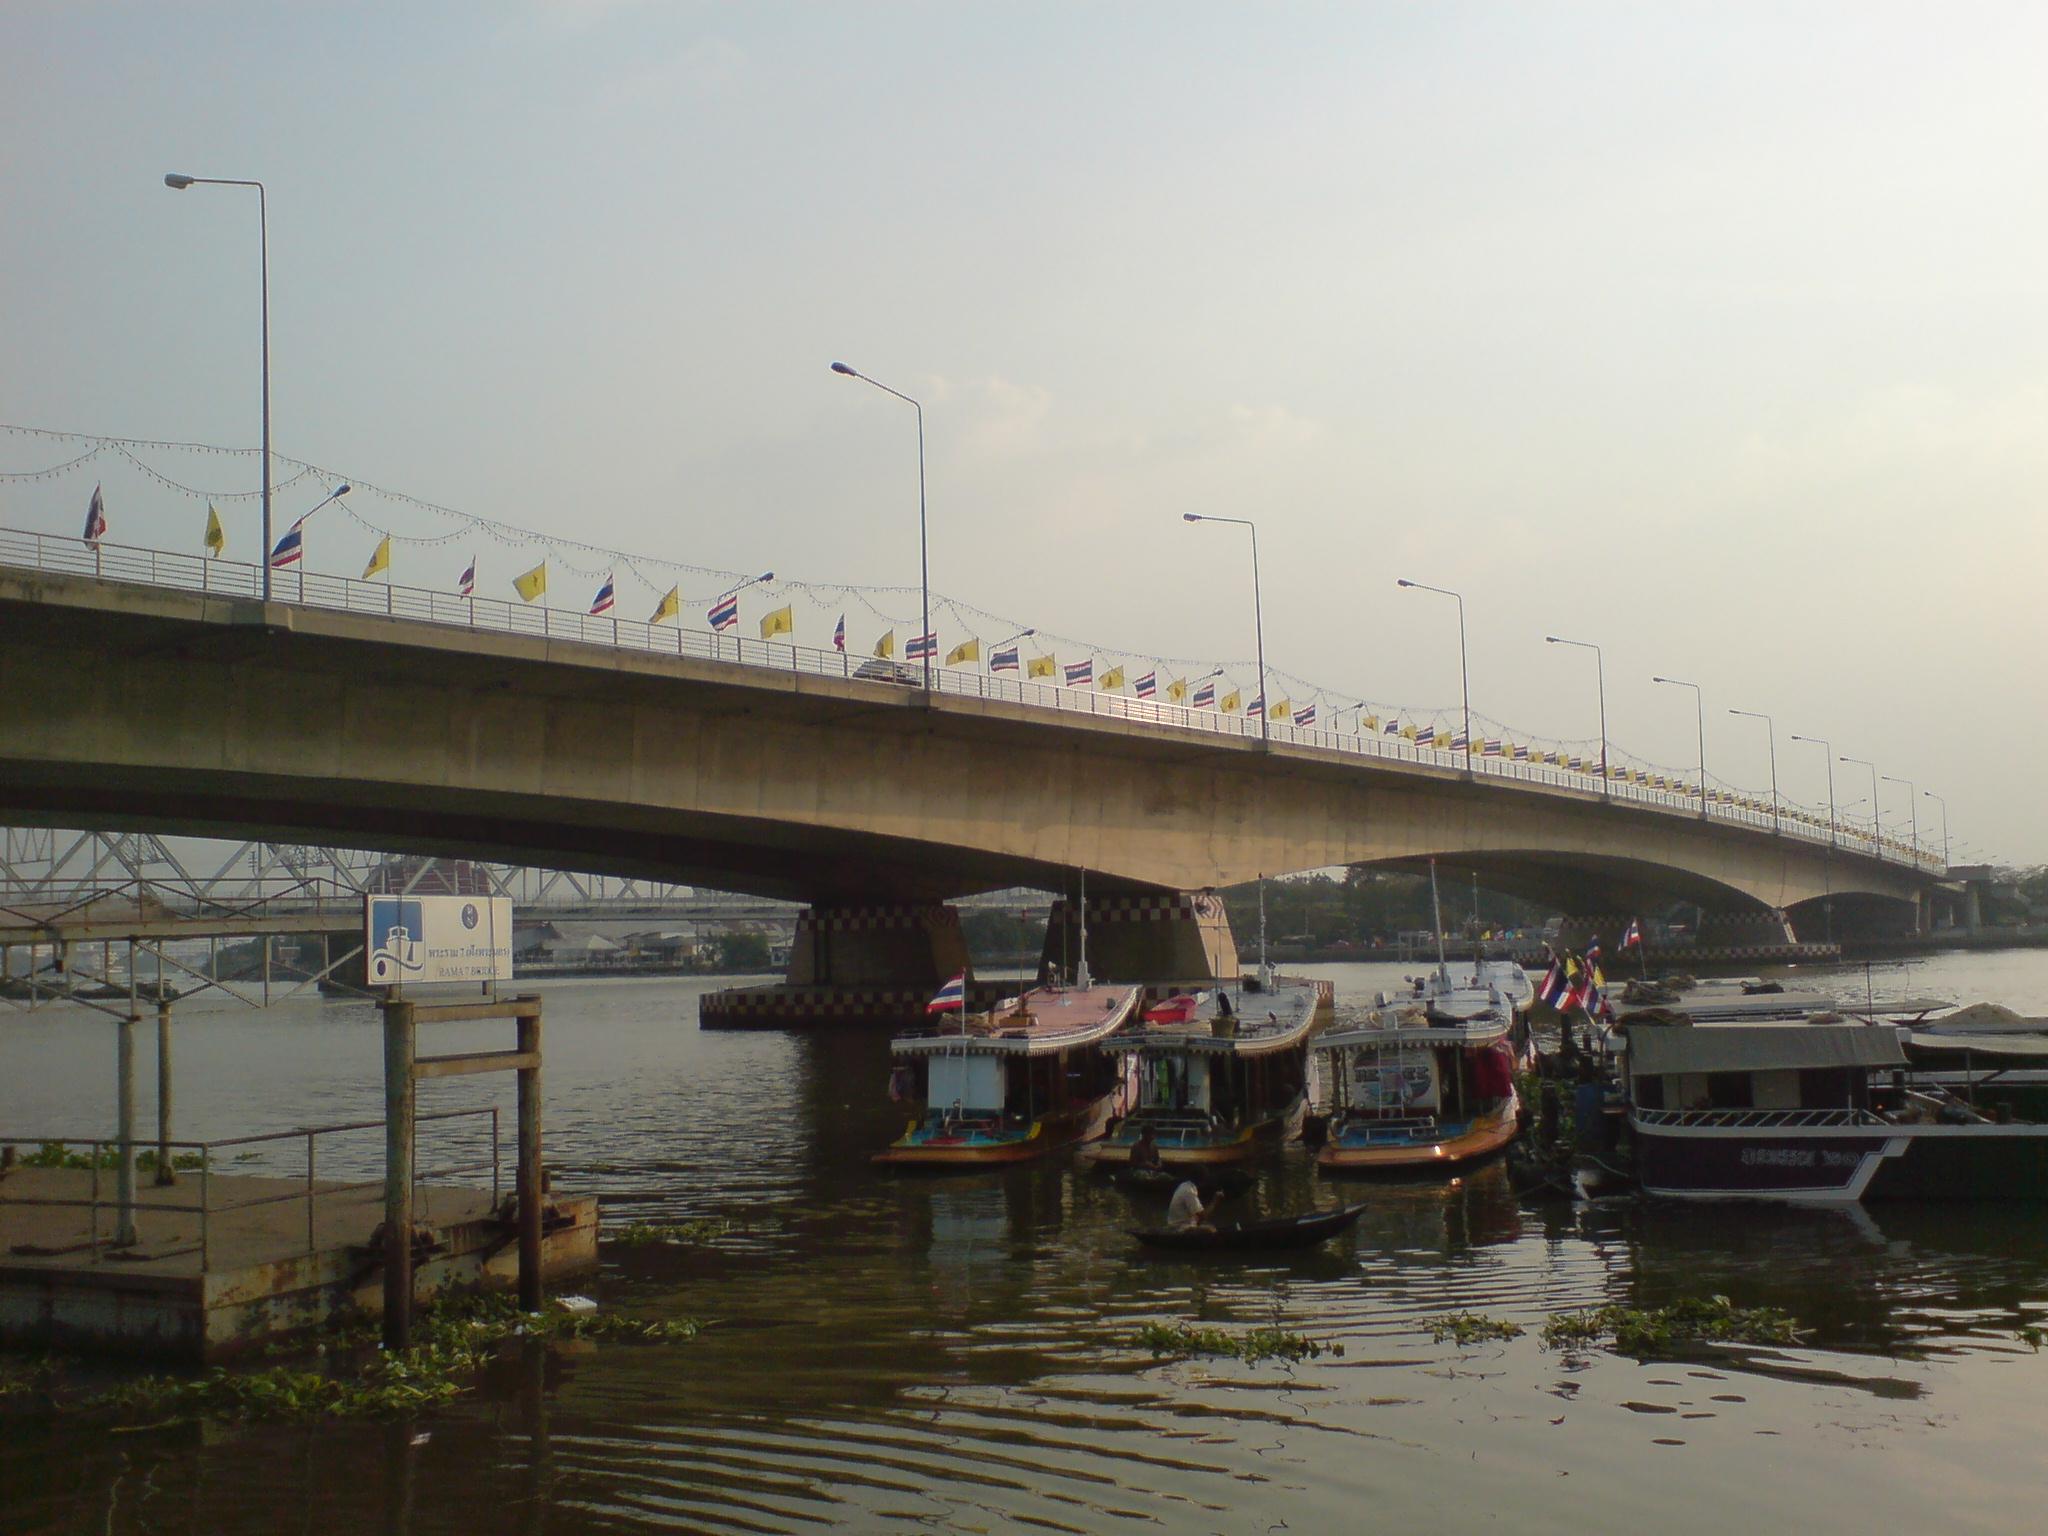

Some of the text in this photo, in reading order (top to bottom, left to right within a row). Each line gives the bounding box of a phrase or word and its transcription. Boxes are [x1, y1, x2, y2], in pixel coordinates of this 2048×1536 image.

[428, 948, 458, 958] พระราม
[439, 966, 464, 976] RAMA
